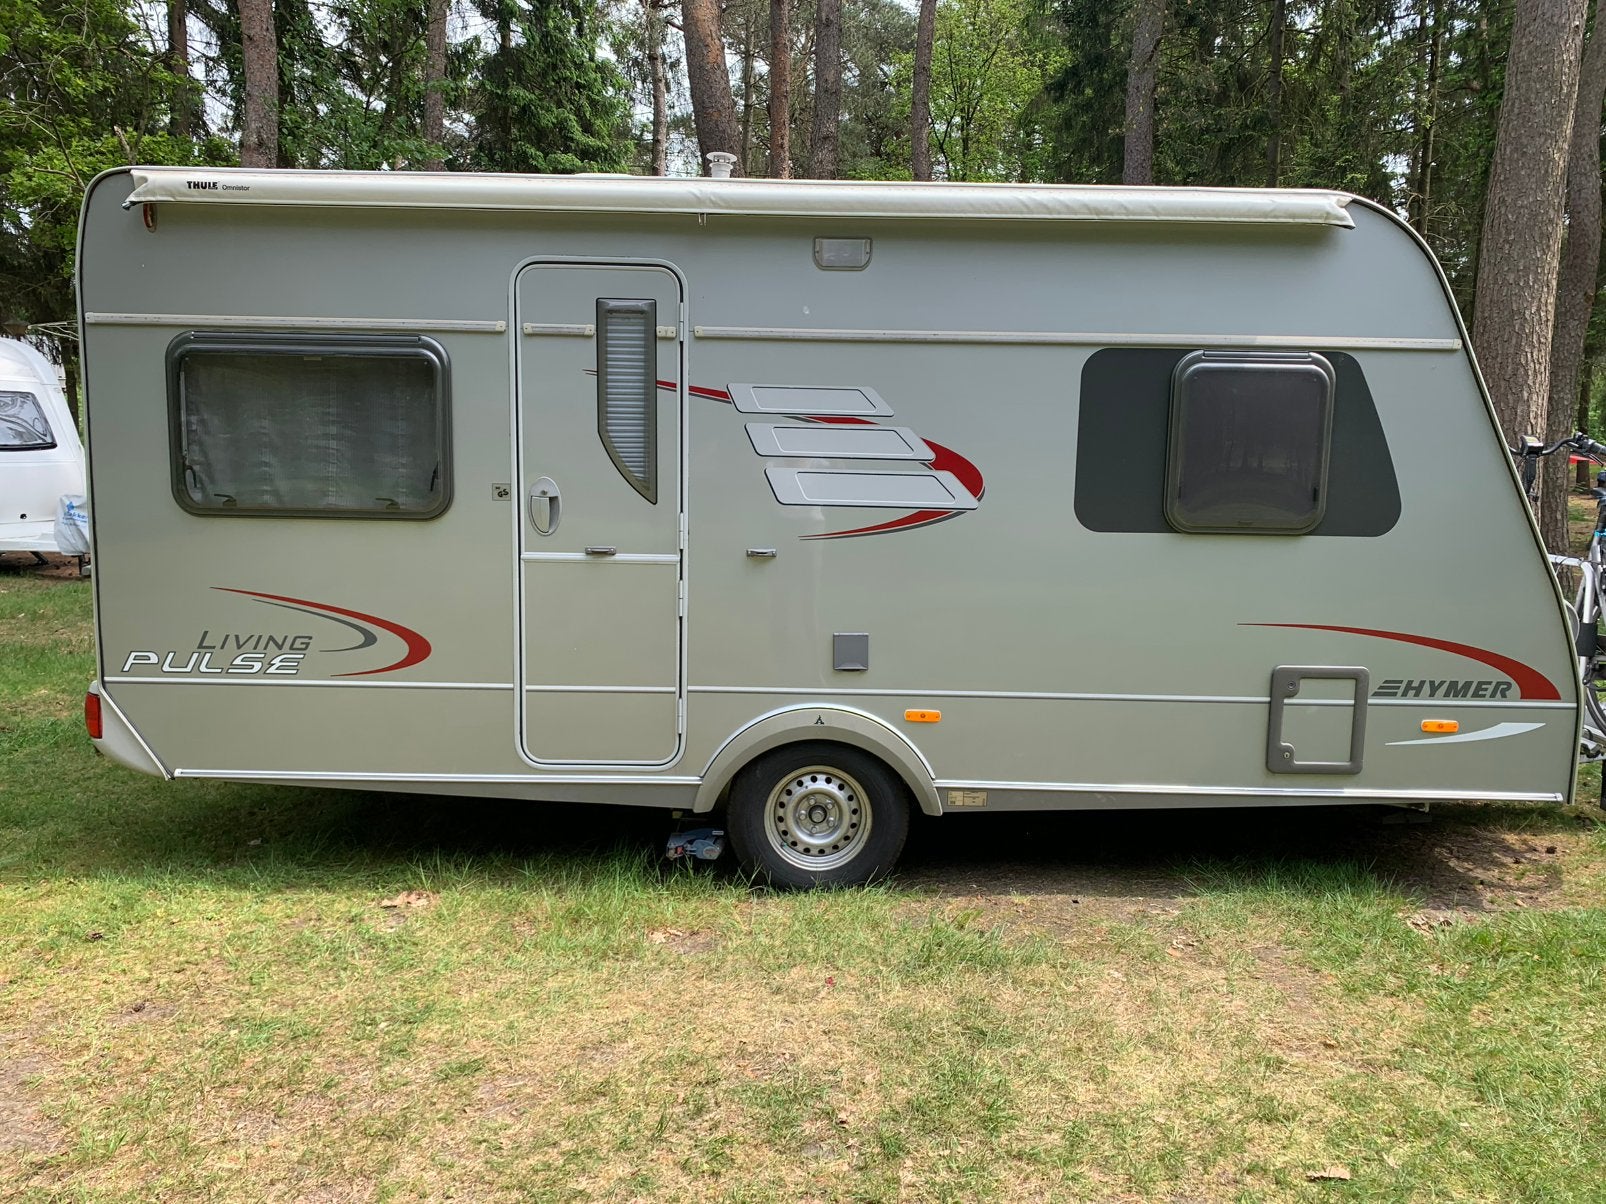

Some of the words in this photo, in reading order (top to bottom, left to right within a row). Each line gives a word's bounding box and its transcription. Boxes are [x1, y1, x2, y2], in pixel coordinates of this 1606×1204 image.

[187, 181, 218, 190] THULE
[197, 630, 313, 651] LIVING
[121, 650, 306, 675] PULSE
[1400, 679, 1513, 699] HYMER
